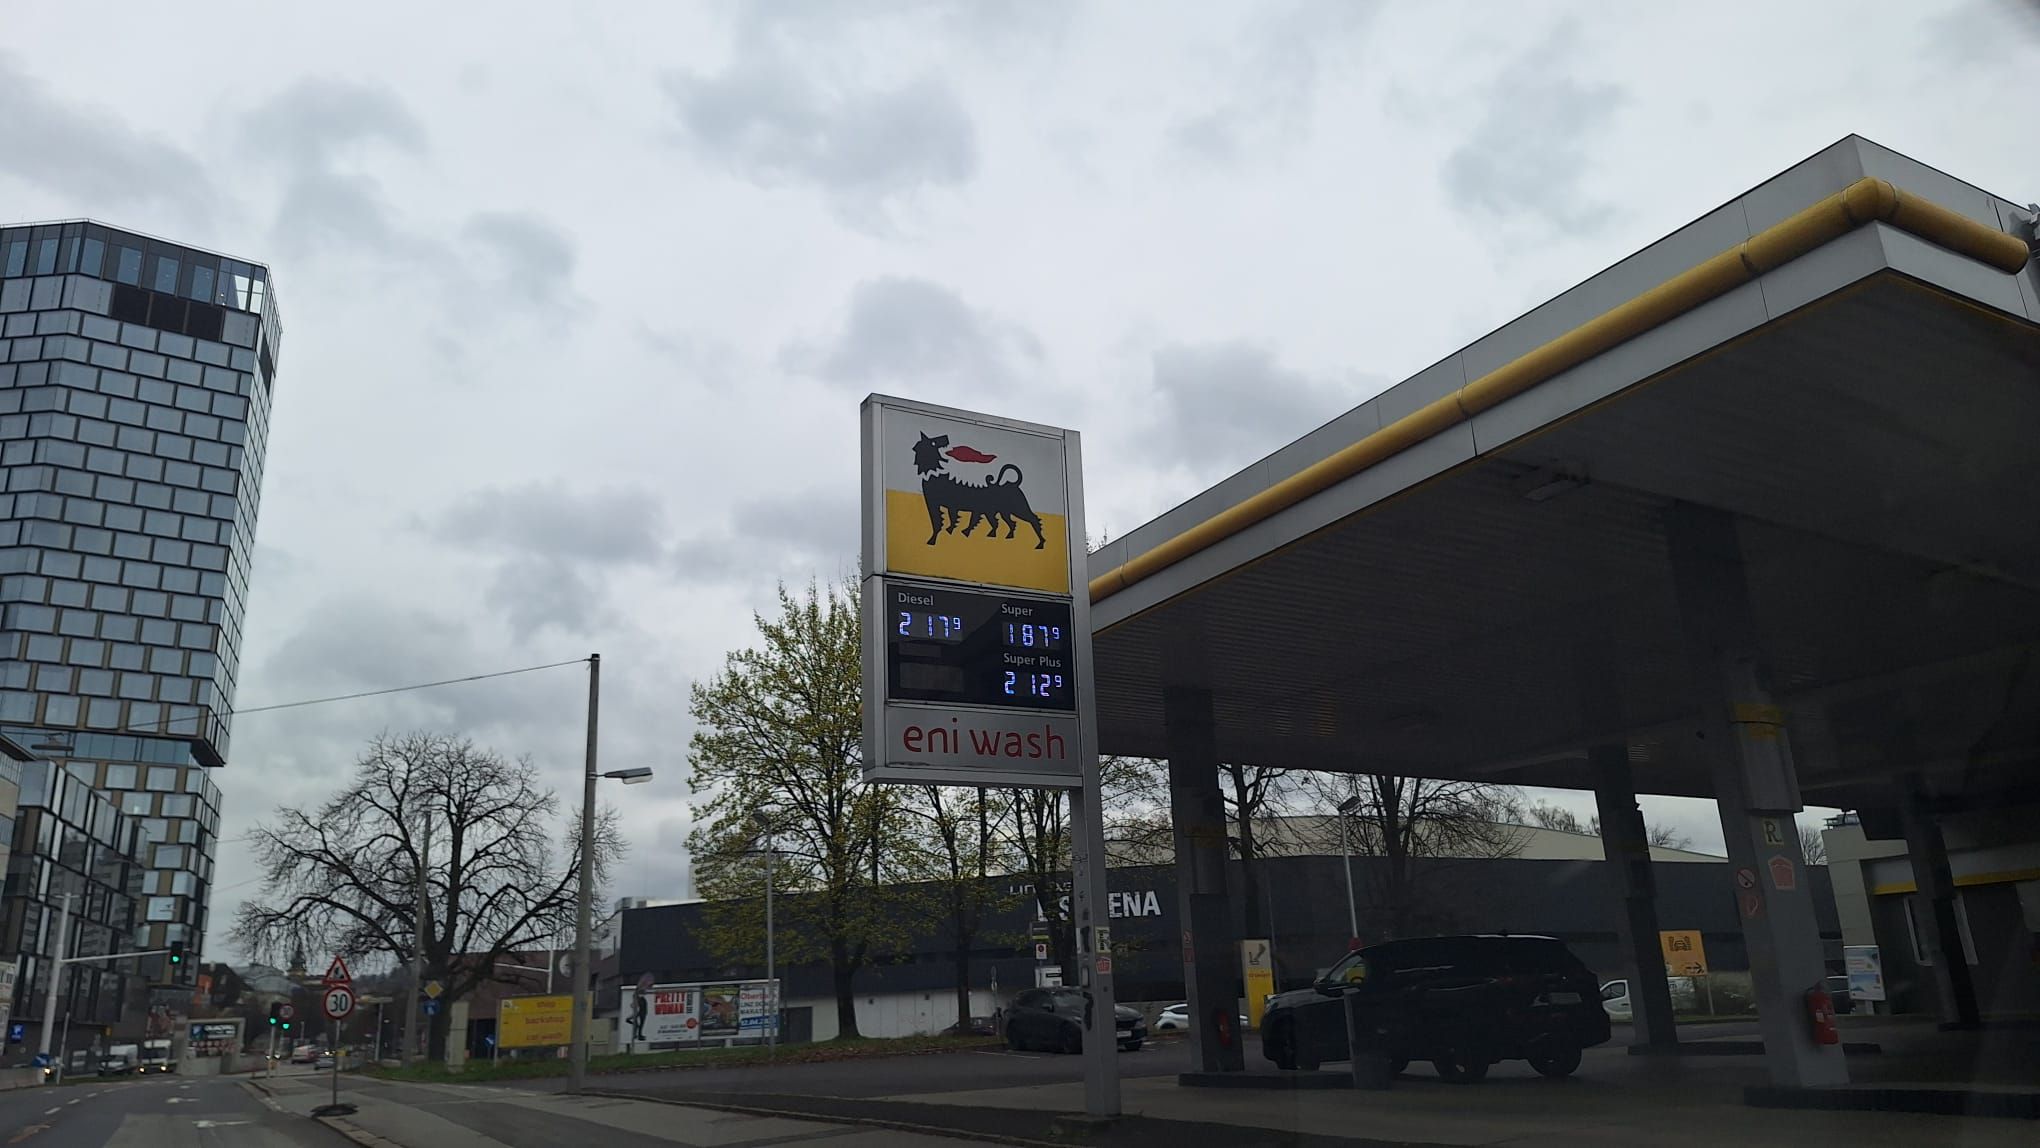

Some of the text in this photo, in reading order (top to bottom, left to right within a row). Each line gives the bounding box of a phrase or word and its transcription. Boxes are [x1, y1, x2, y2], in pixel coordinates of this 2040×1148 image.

[898, 592, 934, 606] Diesel
[1001, 603, 1033, 617] Super
[1003, 652, 1062, 668] Super Plus
[903, 718, 1065, 760] eni wash
[330, 993, 348, 1012] 30
[655, 992, 685, 1003] PRETTY
